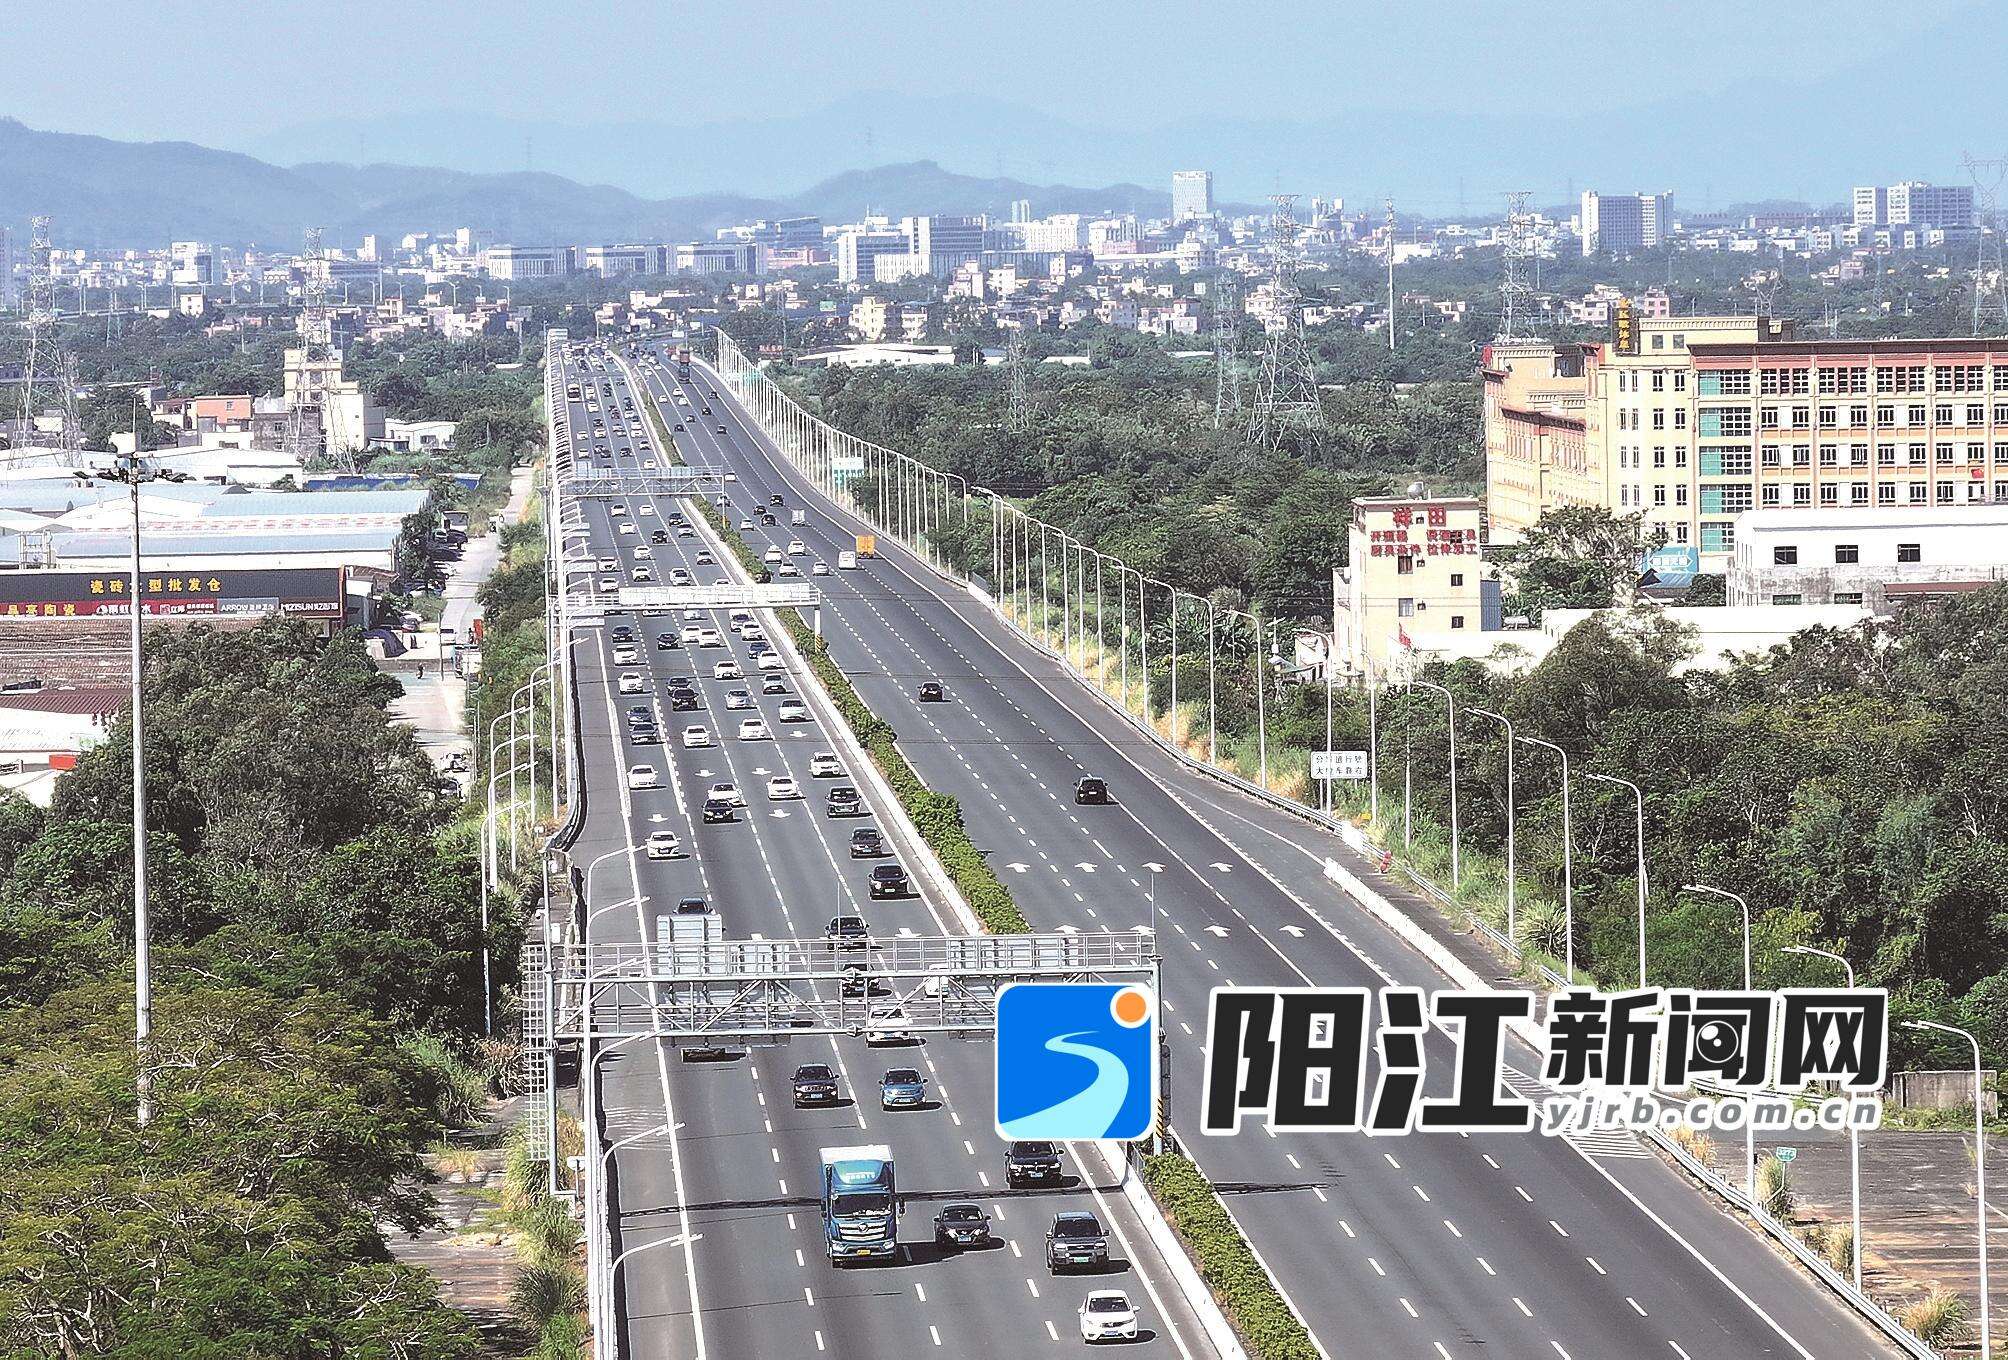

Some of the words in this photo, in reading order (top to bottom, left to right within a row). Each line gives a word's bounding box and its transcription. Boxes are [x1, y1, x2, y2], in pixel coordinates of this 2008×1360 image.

[107, 604, 152, 614] 雨虹水
[220, 604, 249, 612] ARROW
